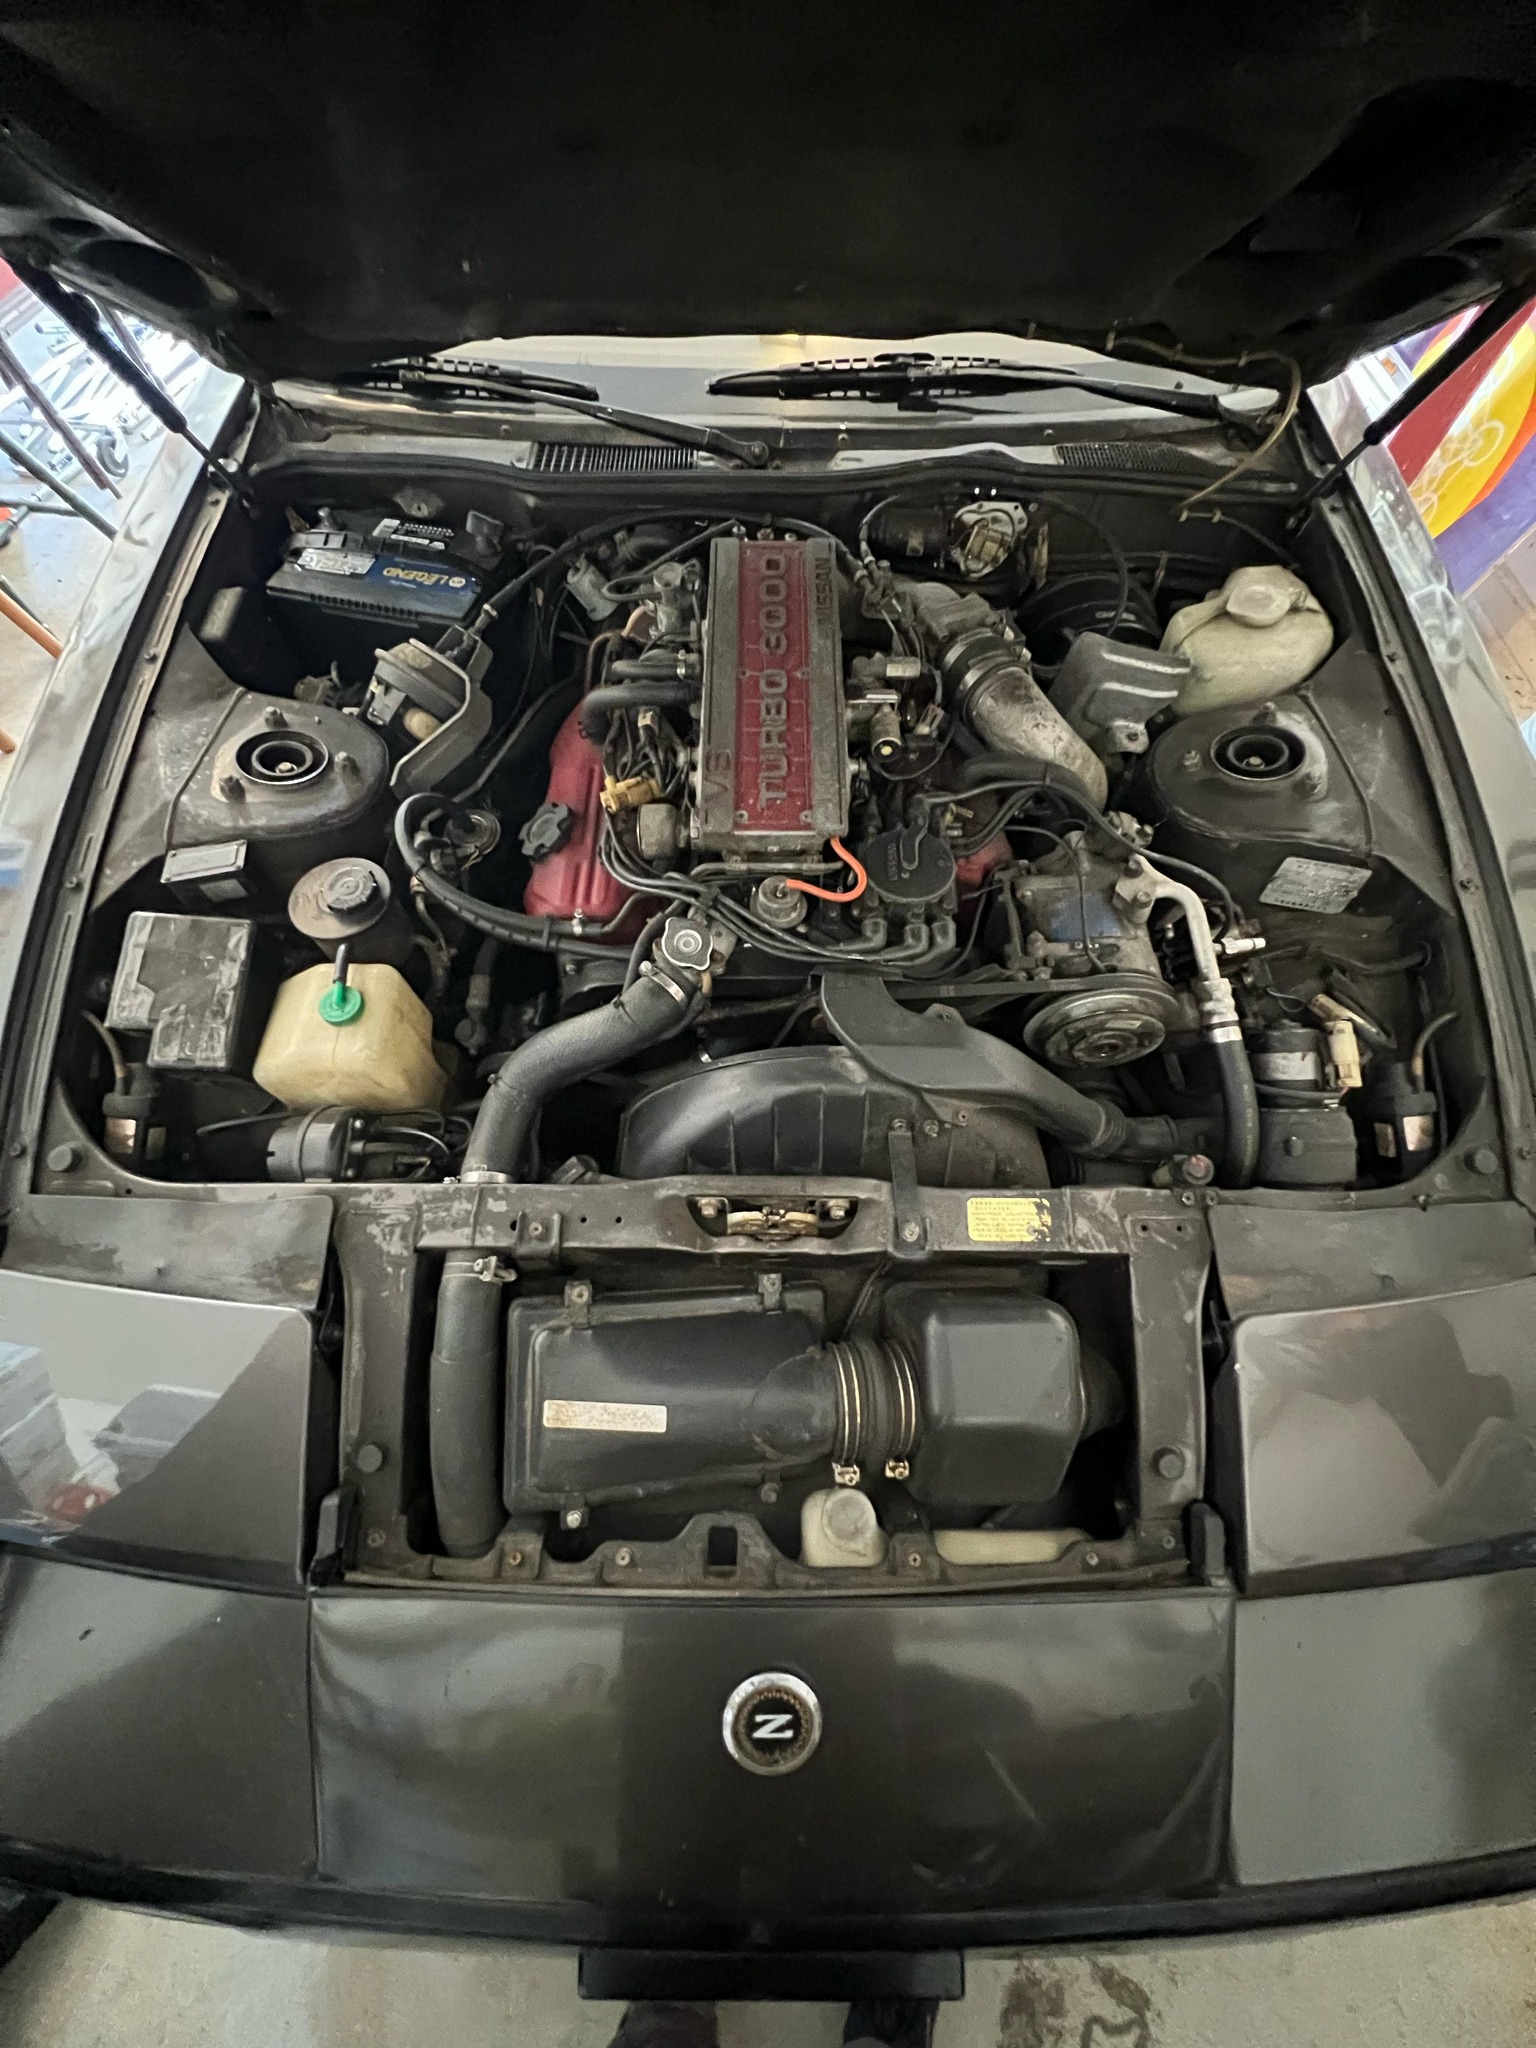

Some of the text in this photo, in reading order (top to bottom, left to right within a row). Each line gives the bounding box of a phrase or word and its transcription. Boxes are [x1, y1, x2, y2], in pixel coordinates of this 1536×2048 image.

[382, 566, 449, 586] LEGEND
[814, 556, 833, 626] NISSAN
[758, 553, 789, 811] TURBO 3000
[704, 750, 731, 803] V6
[751, 1713, 794, 1739] Z
